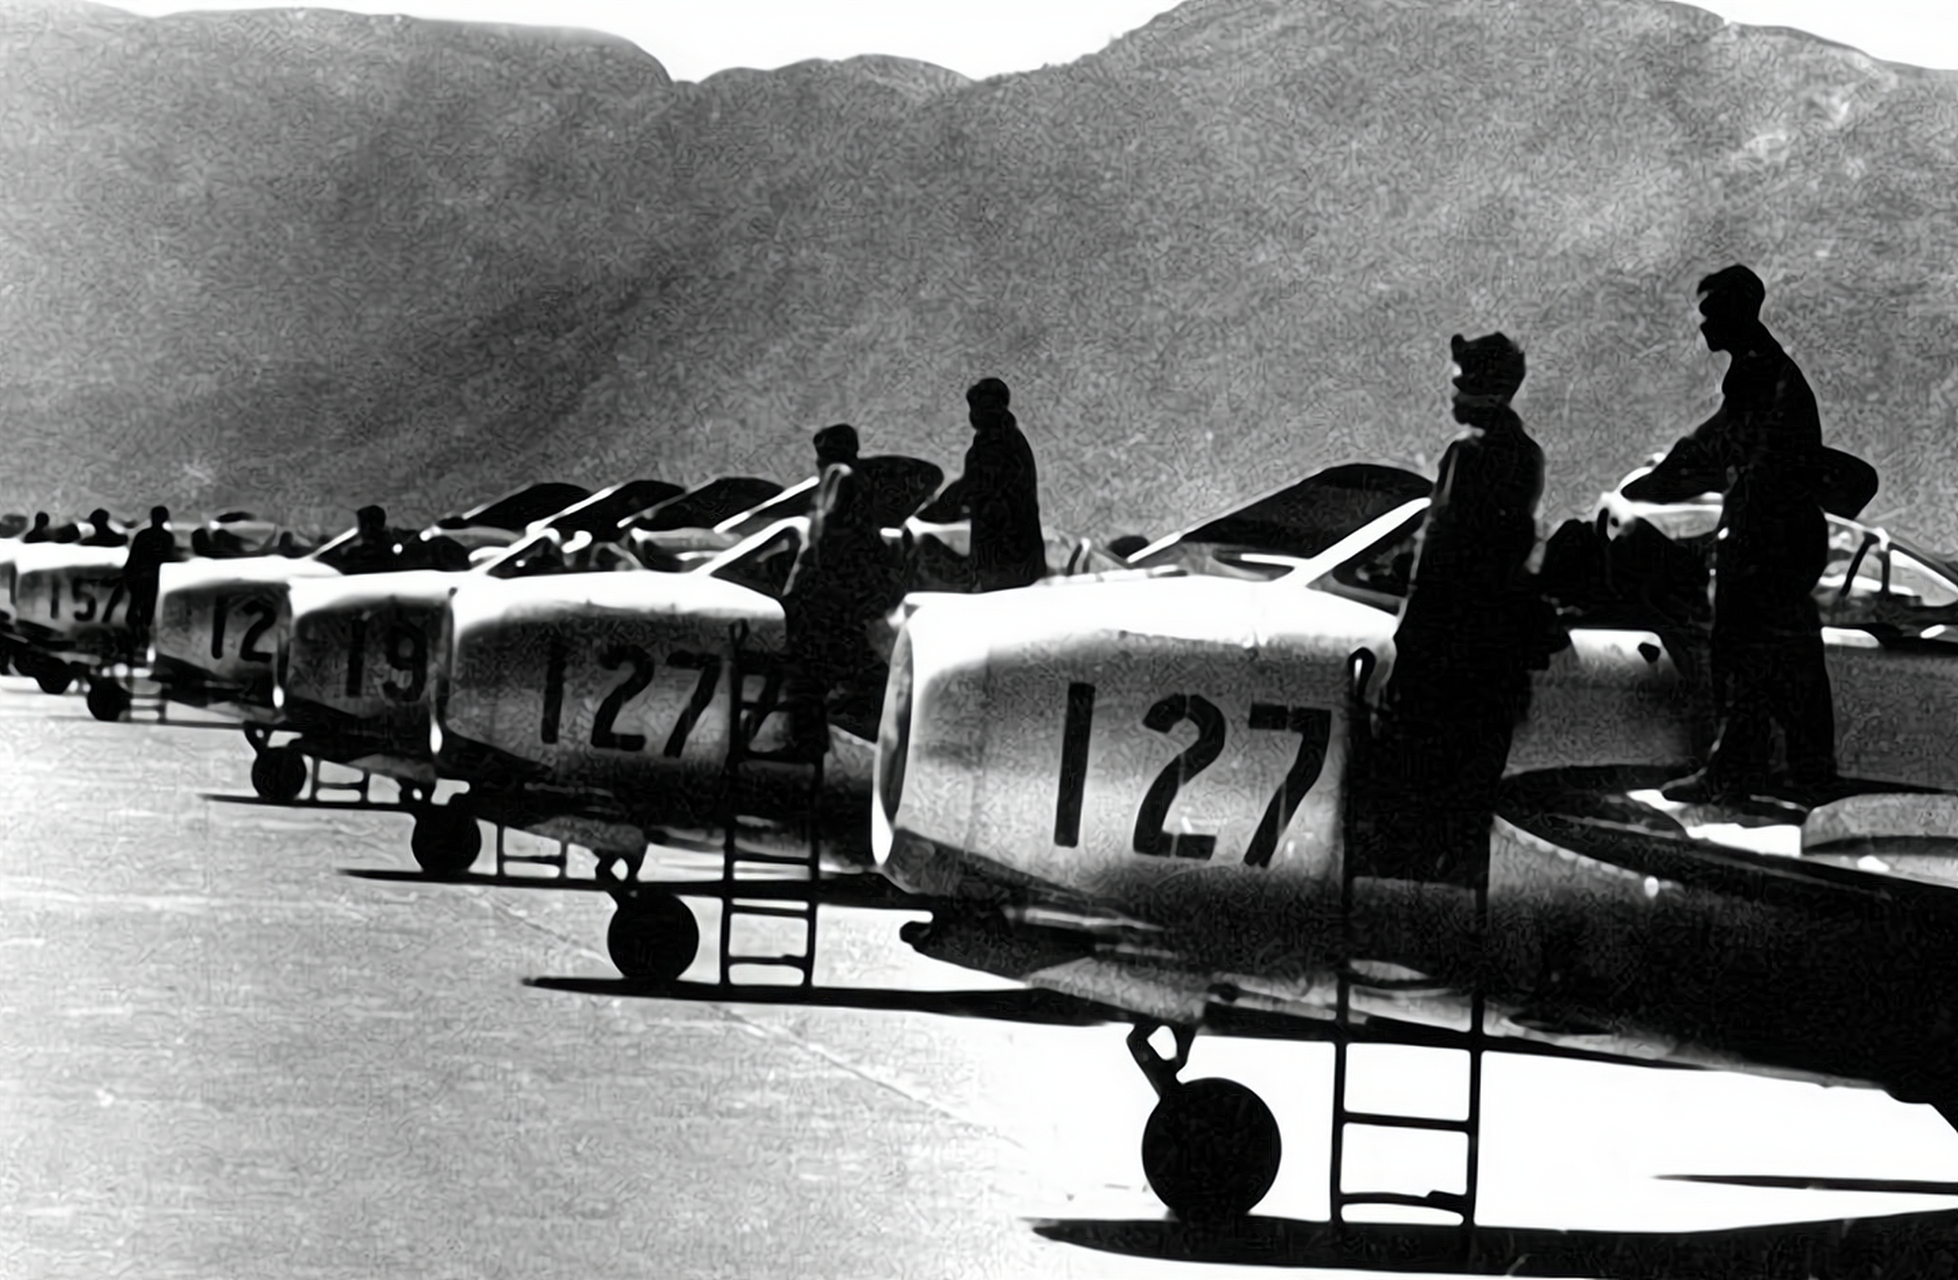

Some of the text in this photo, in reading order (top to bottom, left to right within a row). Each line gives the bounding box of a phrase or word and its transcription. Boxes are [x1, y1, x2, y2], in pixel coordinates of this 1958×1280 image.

[212, 595, 277, 662] 12
[346, 619, 427, 702] 19
[1054, 682, 1331, 868] 127
